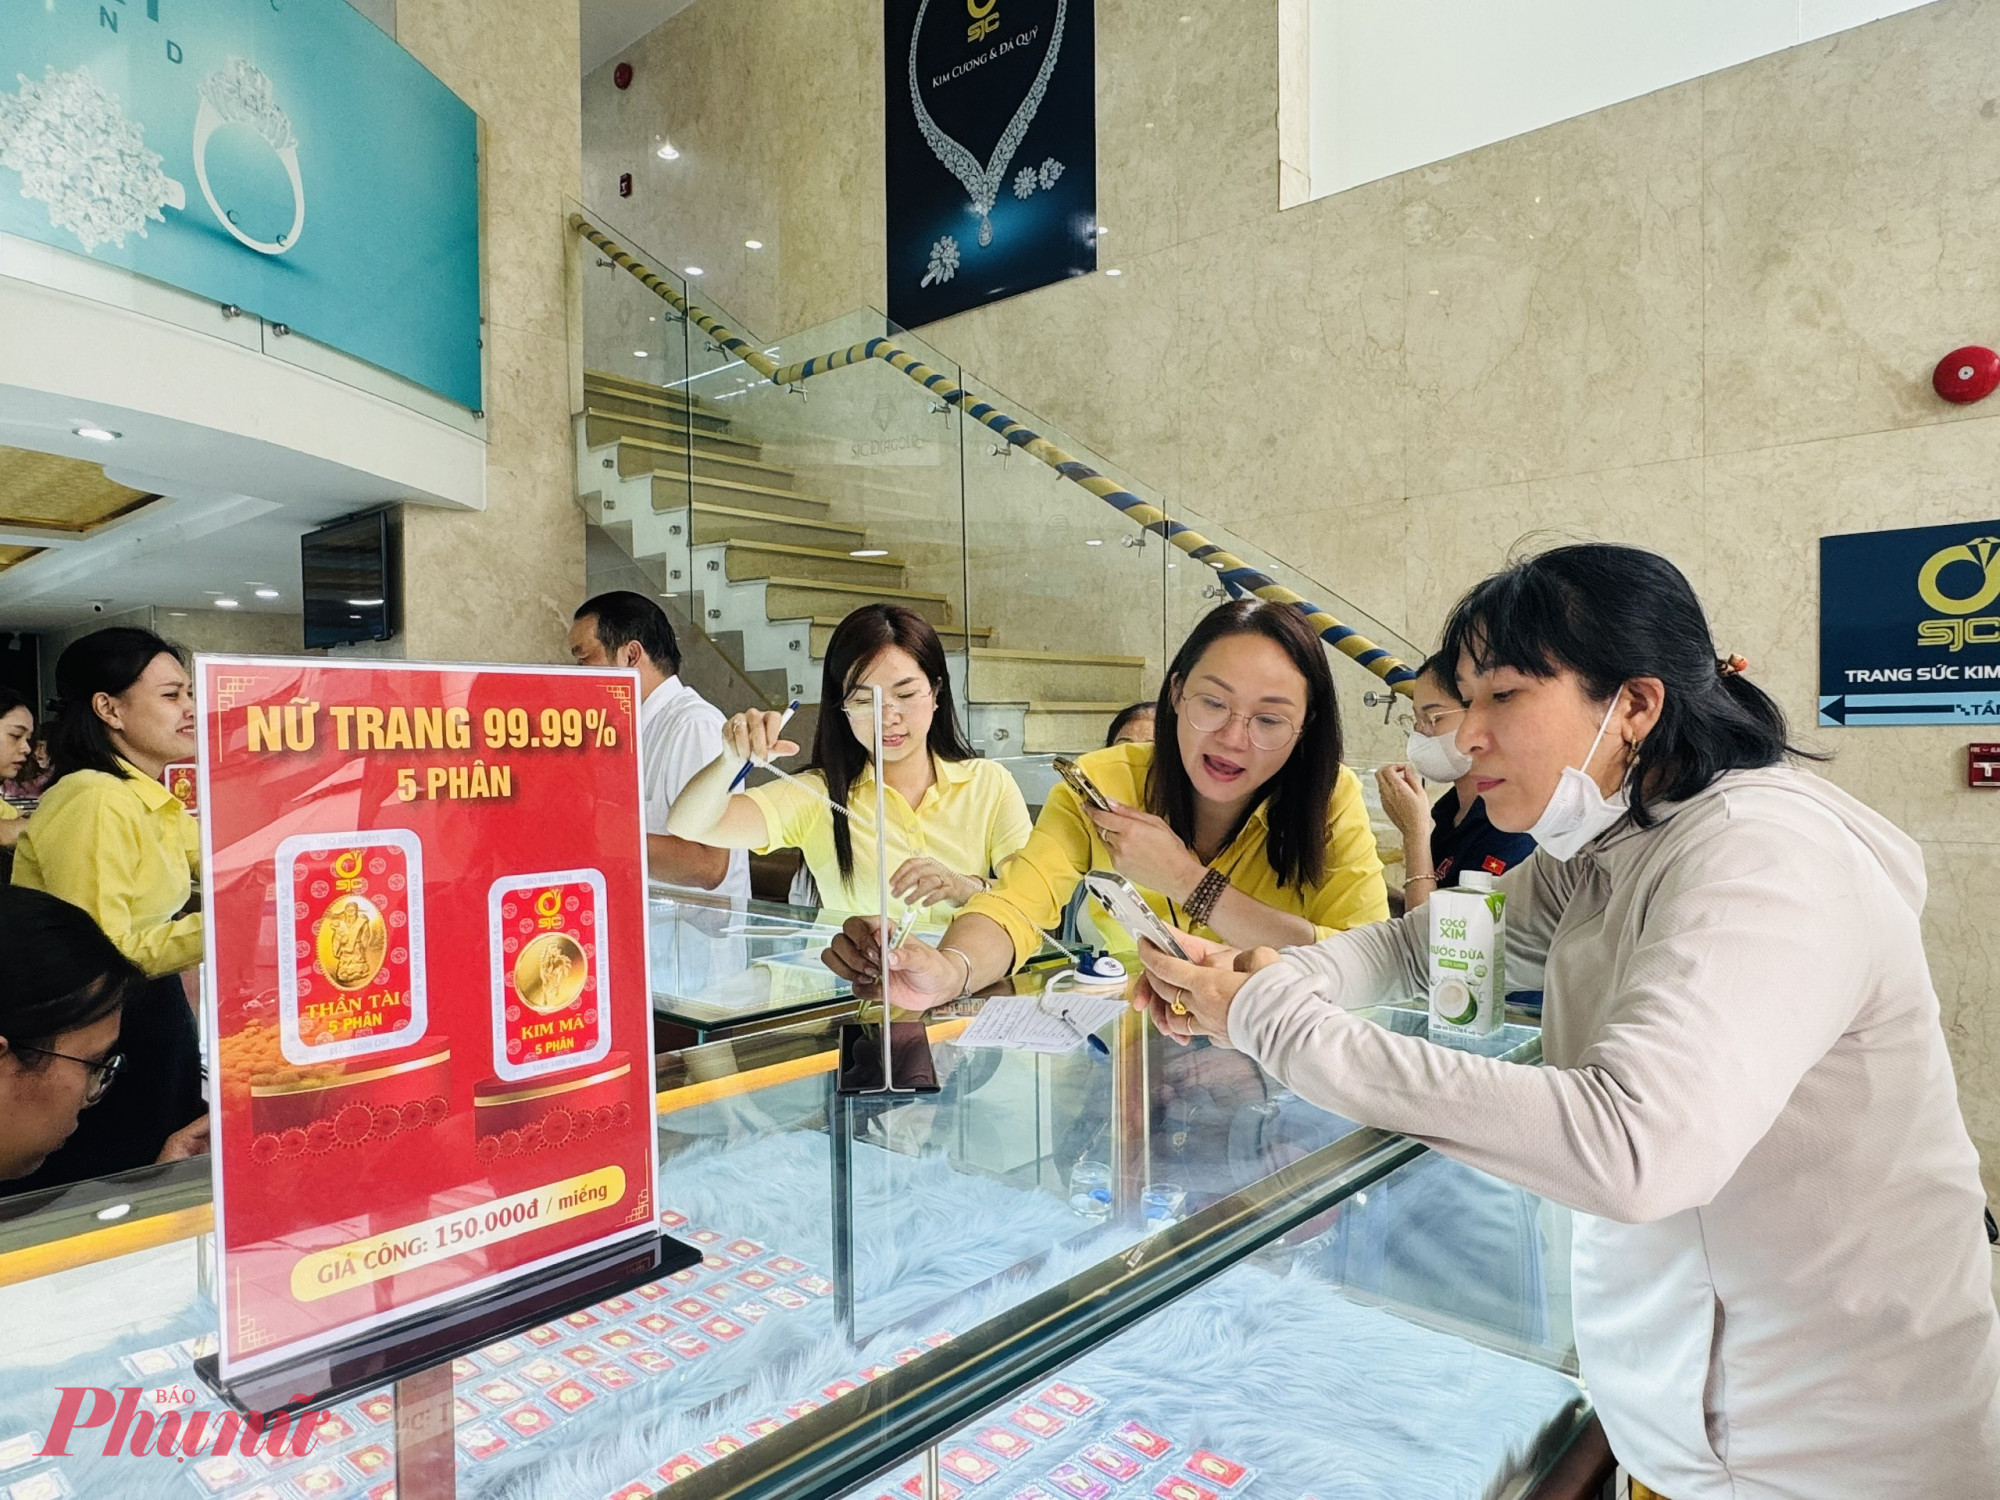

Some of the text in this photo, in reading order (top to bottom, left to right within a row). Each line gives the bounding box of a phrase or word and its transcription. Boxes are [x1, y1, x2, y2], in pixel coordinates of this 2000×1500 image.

[967, 12, 1000, 43] SJC
[932, 72, 950, 88] KIM
[989, 47, 998, 60] &
[1917, 616, 2000, 652] SJC
[1845, 663, 2000, 683] TRANG SỨC KIM
[246, 696, 617, 752] NỮ TRANG 99.99%
[397, 760, 512, 802] 5 PHÂN
[335, 879, 363, 892] SJC
[1440, 927, 1466, 941] XIM
[1460, 948, 1484, 960] DỪA
[305, 989, 400, 1019] THẦN TÀI
[328, 1011, 383, 1034] 5 PHÂN
[521, 1013, 584, 1040] KIM MÃ
[535, 1036, 575, 1055] 5 PHÂN
[317, 1252, 357, 1285] GIÁ
[363, 1237, 428, 1270] CÔNG:
[435, 1198, 539, 1249] 150.000đ
[558, 1184, 609, 1211] miếng
